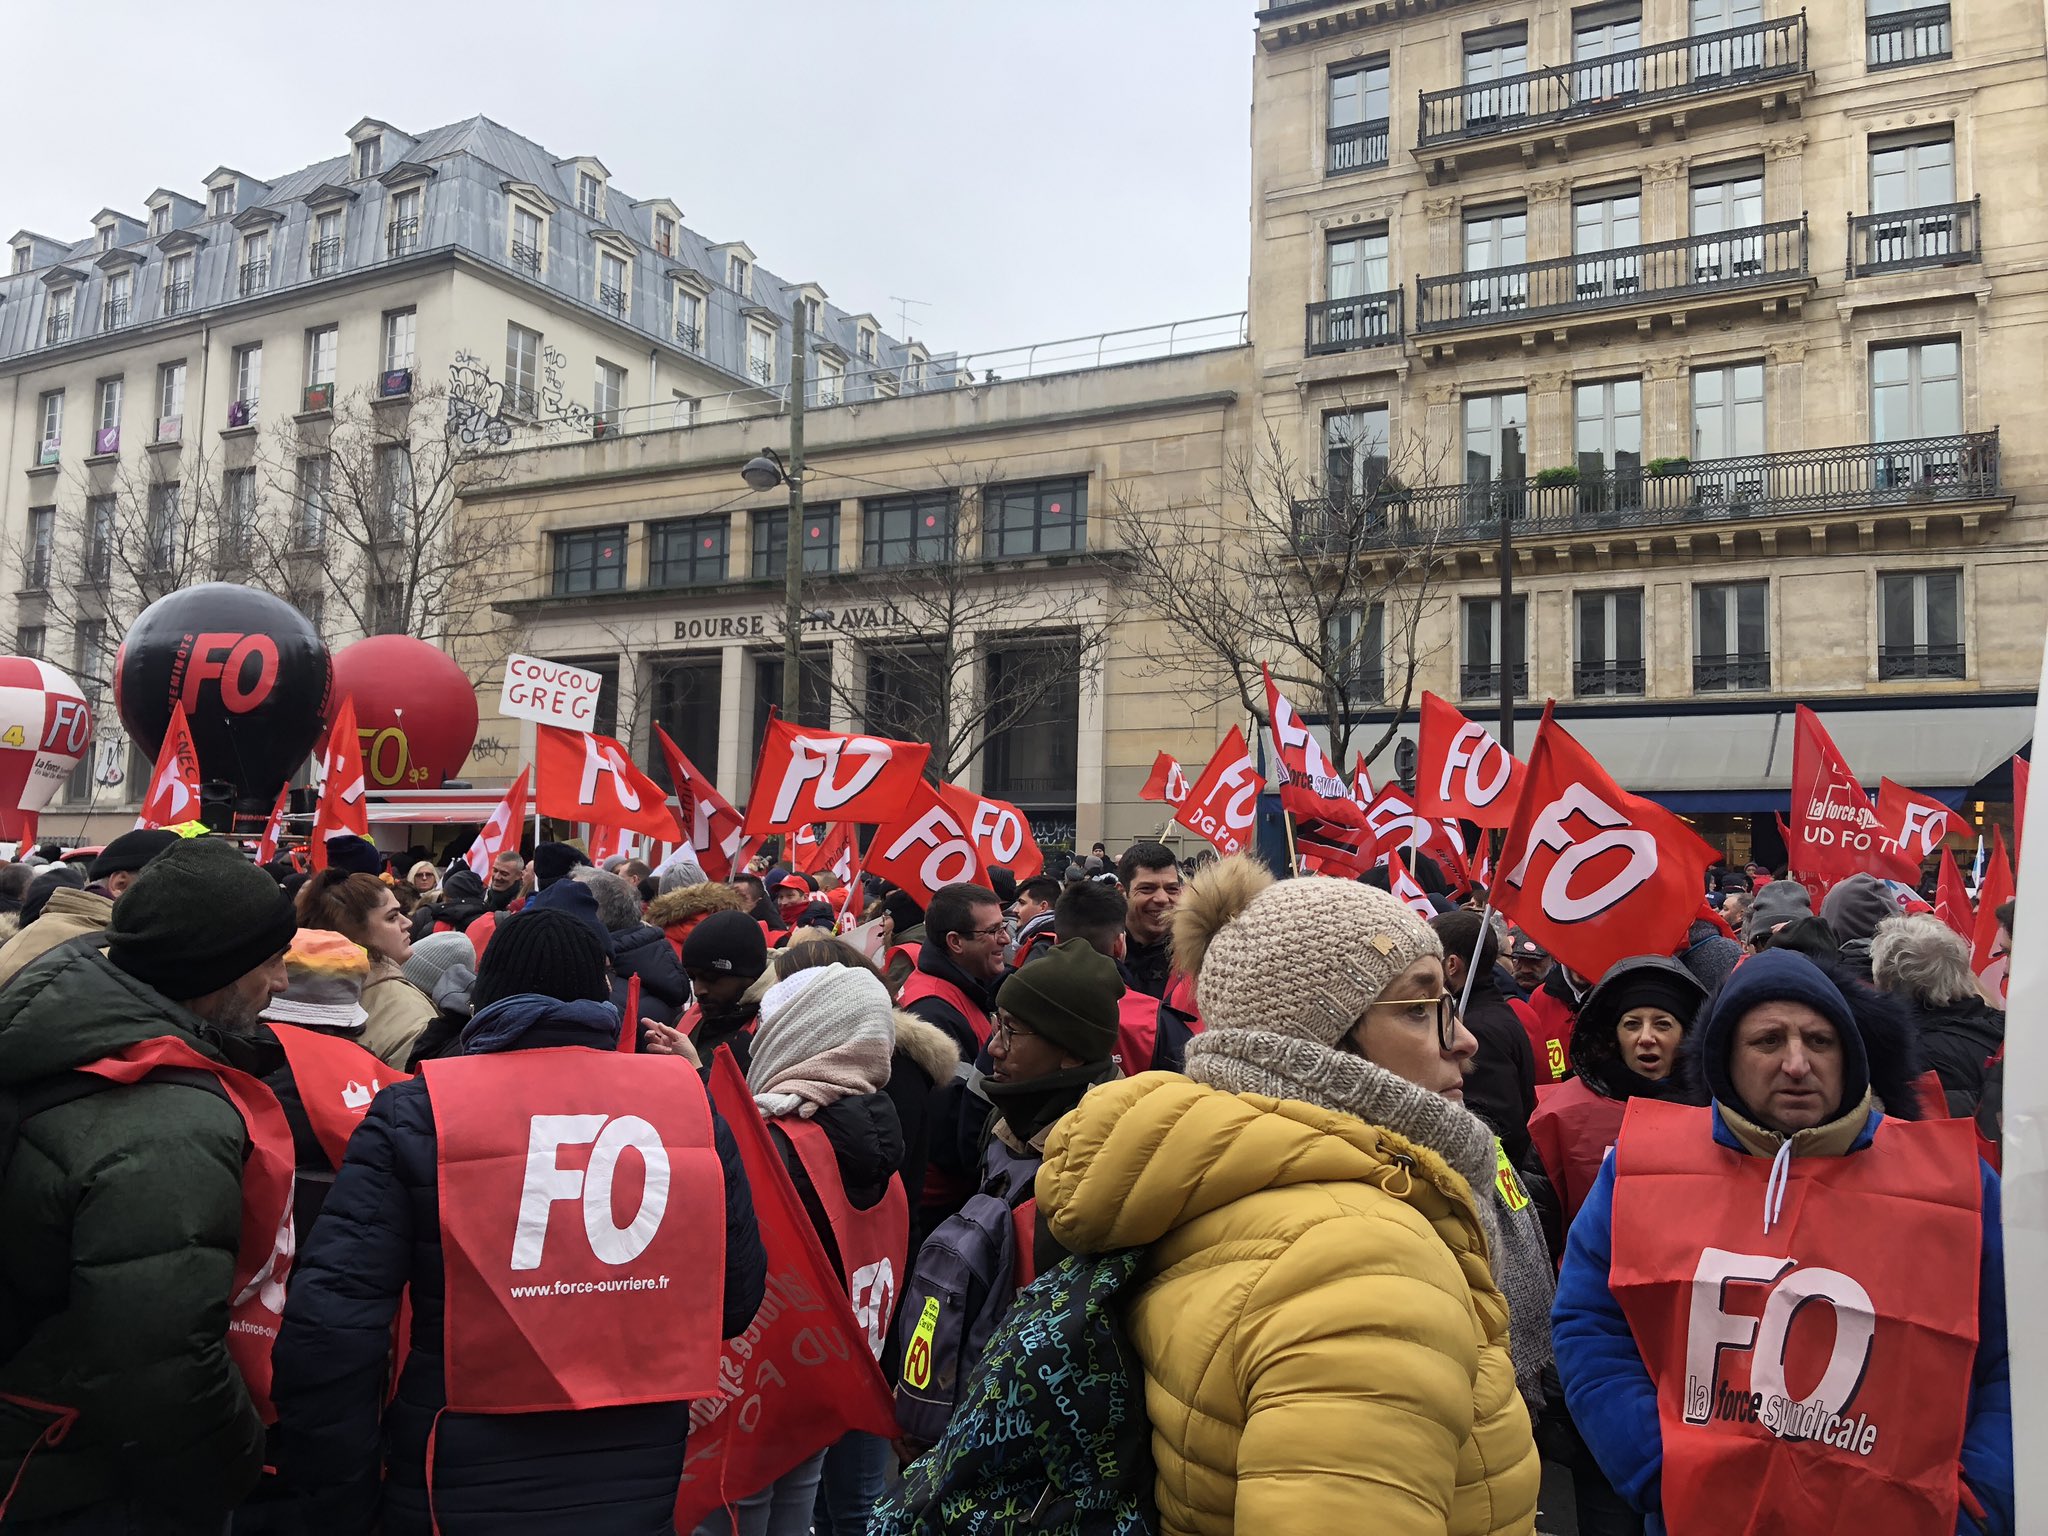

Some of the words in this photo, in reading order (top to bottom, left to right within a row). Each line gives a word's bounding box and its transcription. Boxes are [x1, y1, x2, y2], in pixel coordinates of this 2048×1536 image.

[674, 615, 764, 640] BOURSE
[181, 632, 279, 715] FO
[508, 683, 591, 719] GREG
[510, 659, 601, 693] COUCOU
[44, 700, 89, 753] FO
[408, 766, 429, 783] 93
[769, 734, 893, 825] FO
[1440, 721, 1511, 808] FO
[971, 800, 1023, 864] FO
[1803, 825, 1835, 846] UD
[1841, 830, 1872, 851] FO
[1825, 800, 1856, 822] force
[1899, 801, 1949, 857] FO
[884, 805, 977, 892] FO
[1505, 781, 1658, 924] FO
[511, 1114, 671, 1270] FO
[511, 1275, 670, 1298] www.force-ouvriere.fr
[852, 1257, 894, 1361] FO
[905, 1336, 930, 1386] FO
[1683, 1247, 1876, 1443] FO
[964, 1409, 1034, 1450] Little
[1687, 1375, 1709, 1418] la
[1715, 1380, 1763, 1424] force
[1763, 1394, 1878, 1457] syndicale
